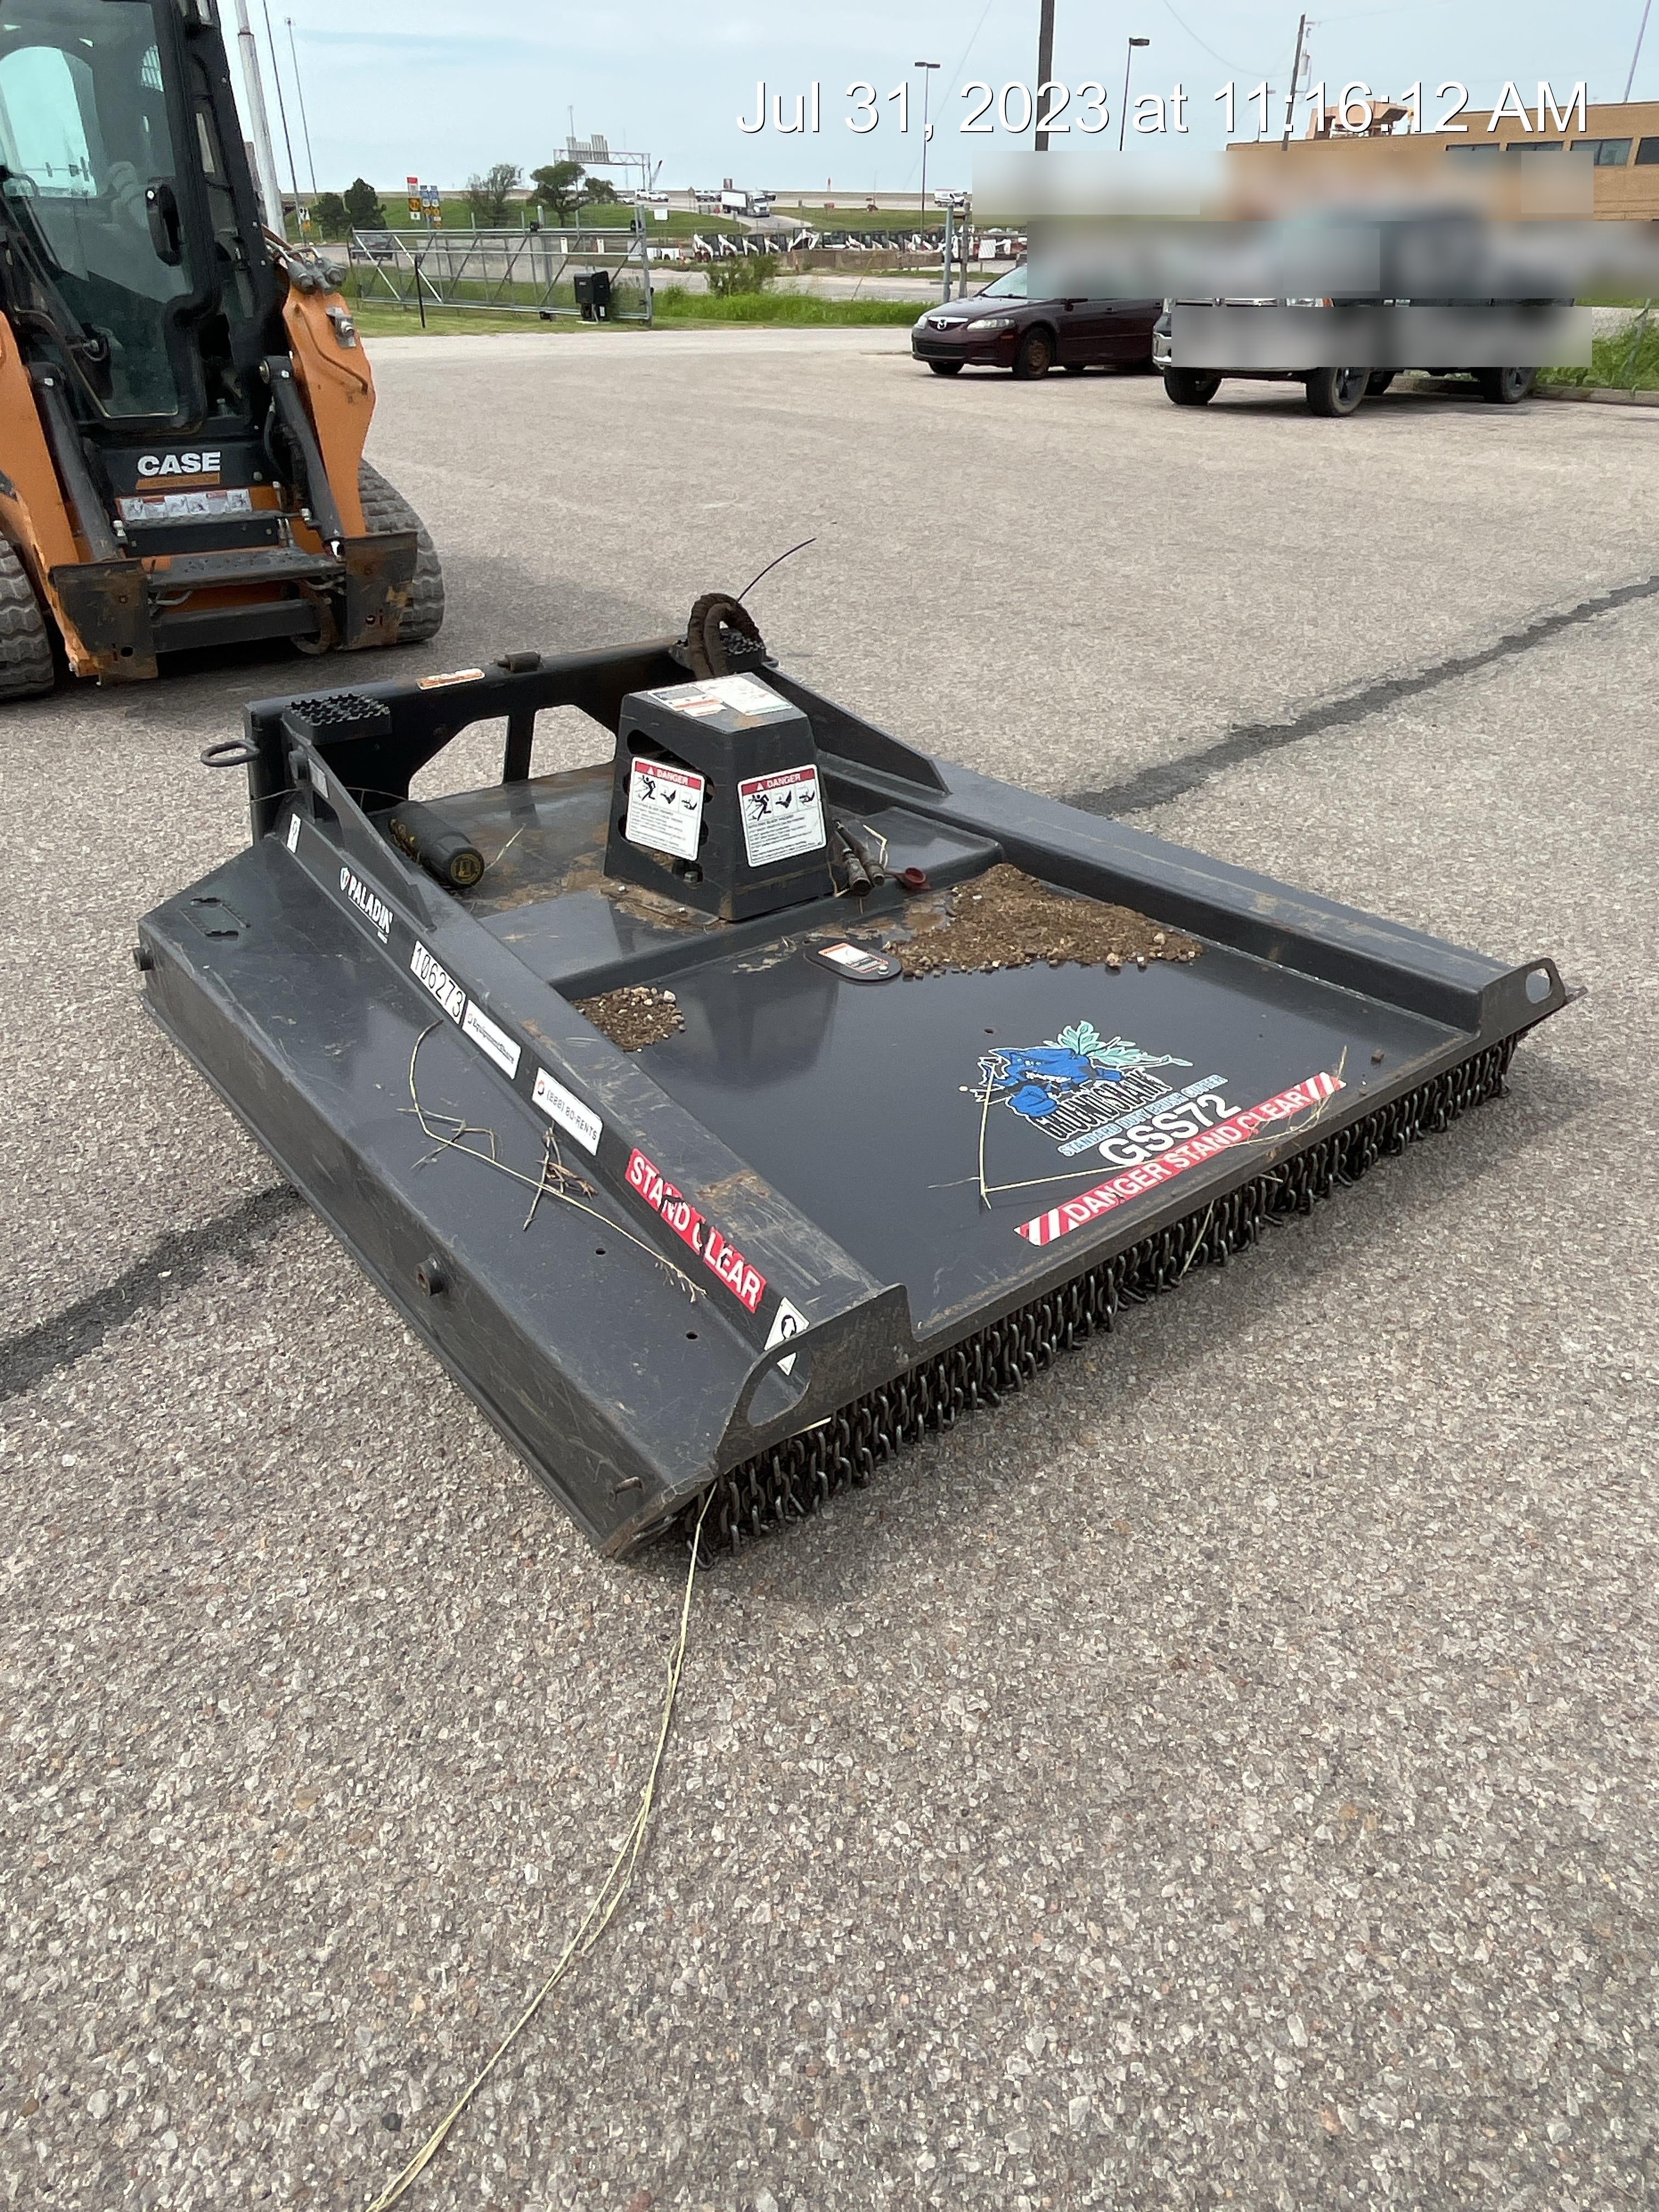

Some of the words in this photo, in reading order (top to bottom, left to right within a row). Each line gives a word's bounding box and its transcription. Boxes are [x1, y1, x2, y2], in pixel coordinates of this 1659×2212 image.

[137, 451, 221, 476] CASE
[657, 770, 689, 786] DANGER
[766, 773, 801, 788] DANGER
[348, 875, 394, 934] PALADIN
[415, 947, 463, 1018] 106273
[1059, 1123, 1122, 1156] STANDARD
[1119, 1109, 1153, 1129] DUTY
[1151, 1093, 1184, 1115] BRUSH
[1182, 1075, 1228, 1098] CUTTER
[1098, 1093, 1242, 1166] GSS72
[1066, 1160, 1172, 1222] DANGER
[1165, 1122, 1241, 1169] STAND
[1237, 1089, 1312, 1131] CLEAR
